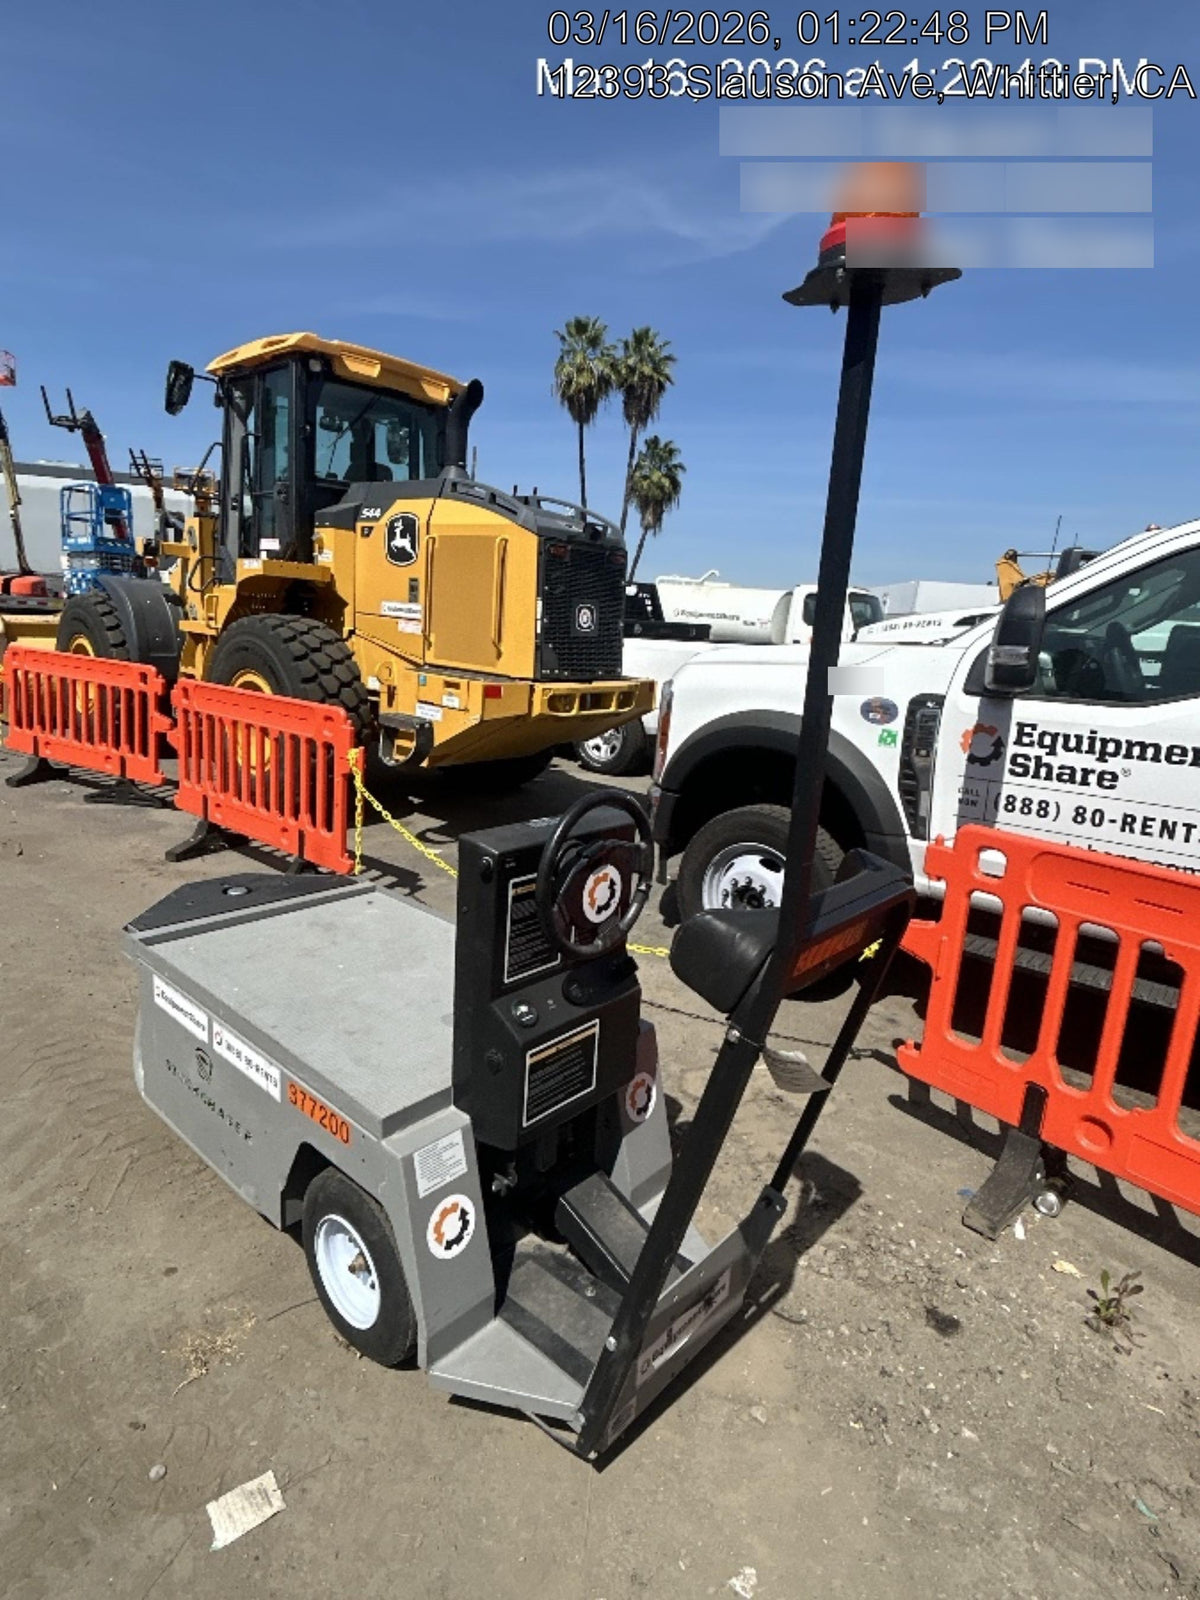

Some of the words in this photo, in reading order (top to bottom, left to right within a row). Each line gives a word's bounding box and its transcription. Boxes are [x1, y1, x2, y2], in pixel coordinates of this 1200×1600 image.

[993, 792, 1061, 822] (888)
[1072, 805, 1200, 844] 80-RENT
[288, 1083, 350, 1144] 377200
